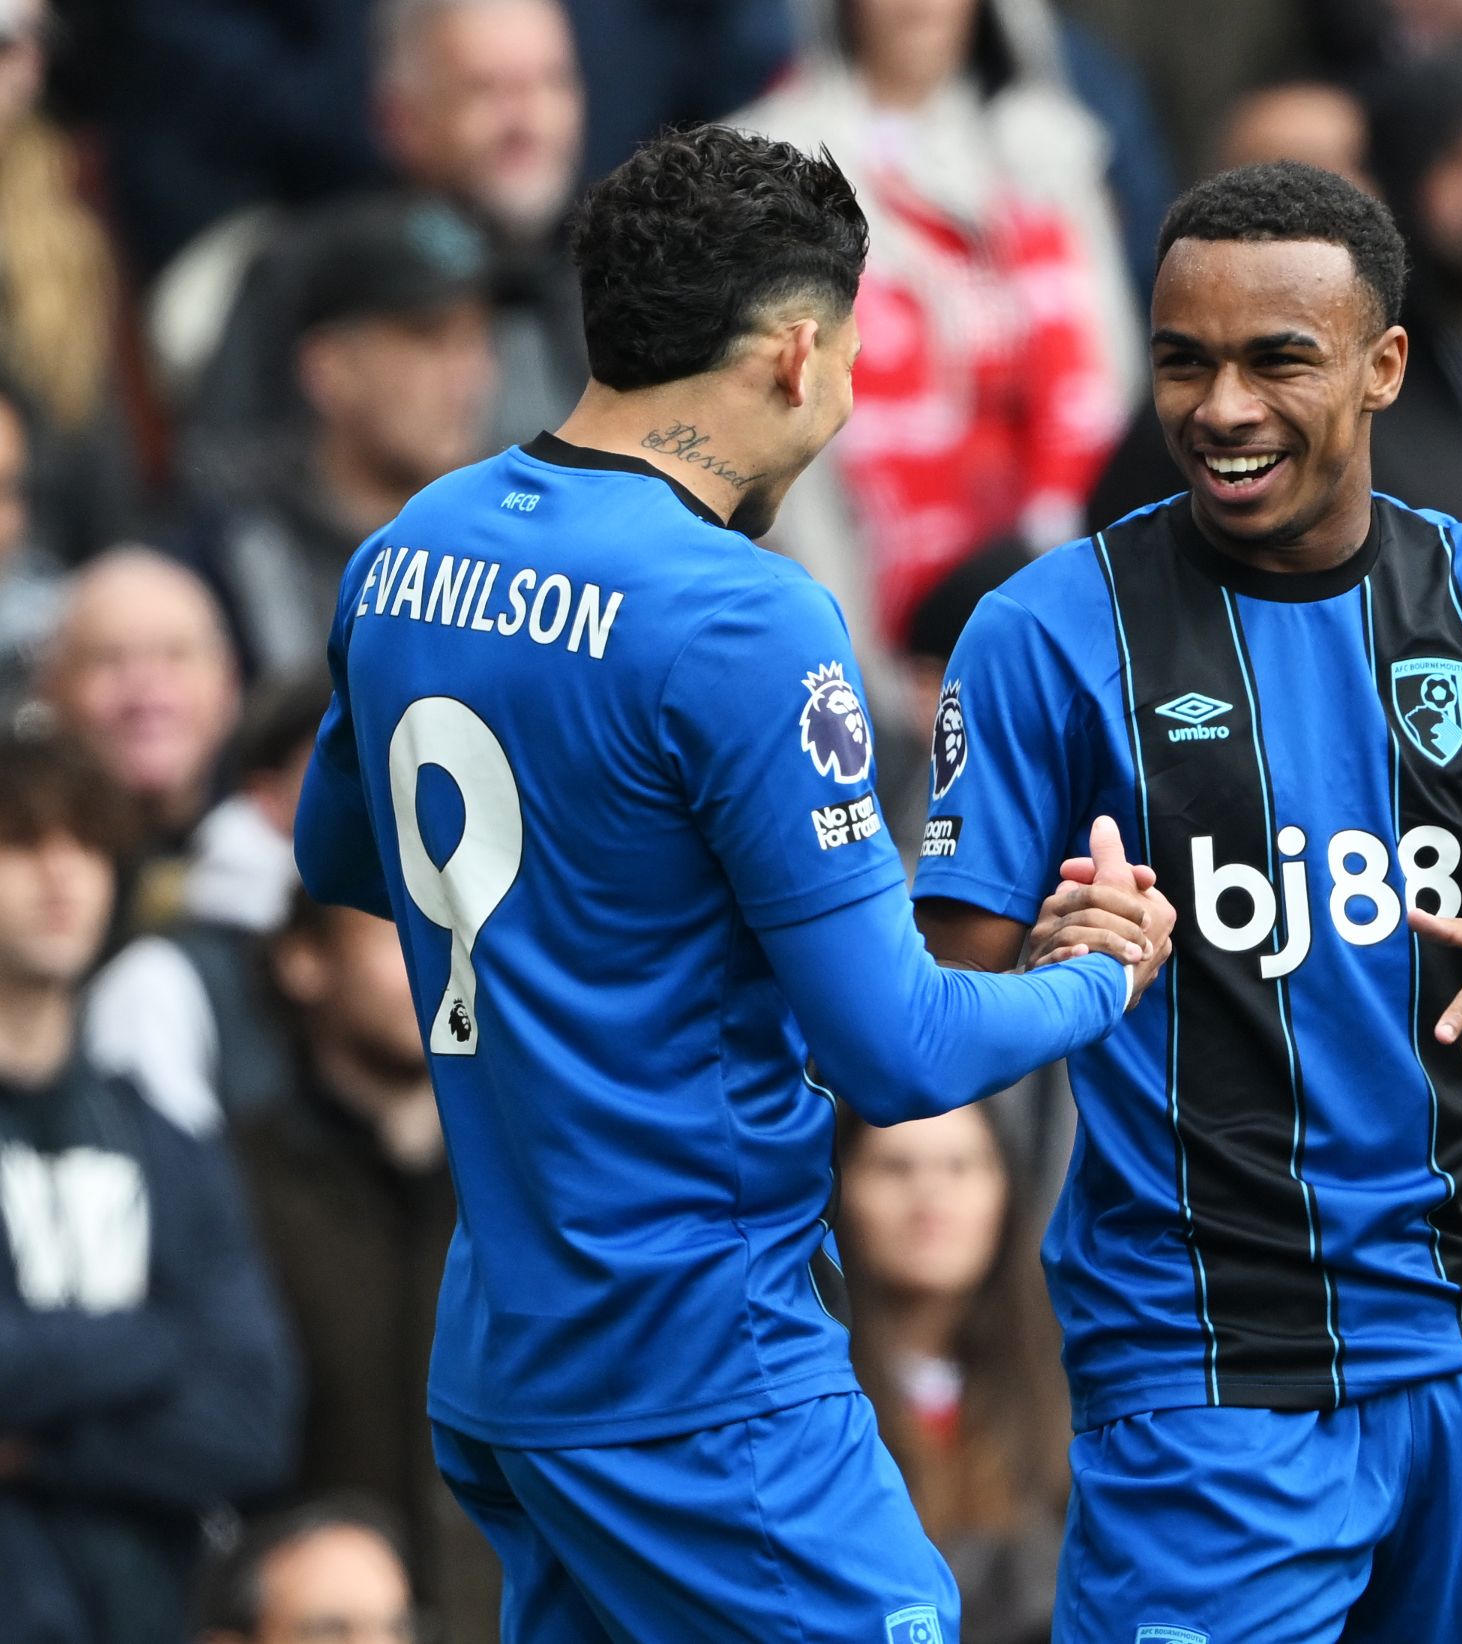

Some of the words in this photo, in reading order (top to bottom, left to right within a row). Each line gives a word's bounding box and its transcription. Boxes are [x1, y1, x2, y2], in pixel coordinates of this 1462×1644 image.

[641, 420, 767, 490] Blessed
[501, 492, 540, 511] AFCB
[356, 546, 624, 660] EVANILSON
[1168, 724, 1230, 742] umbro
[811, 807, 847, 829] No
[817, 825, 850, 850] for
[388, 696, 523, 1054] 9
[1191, 826, 1462, 978] bj88
